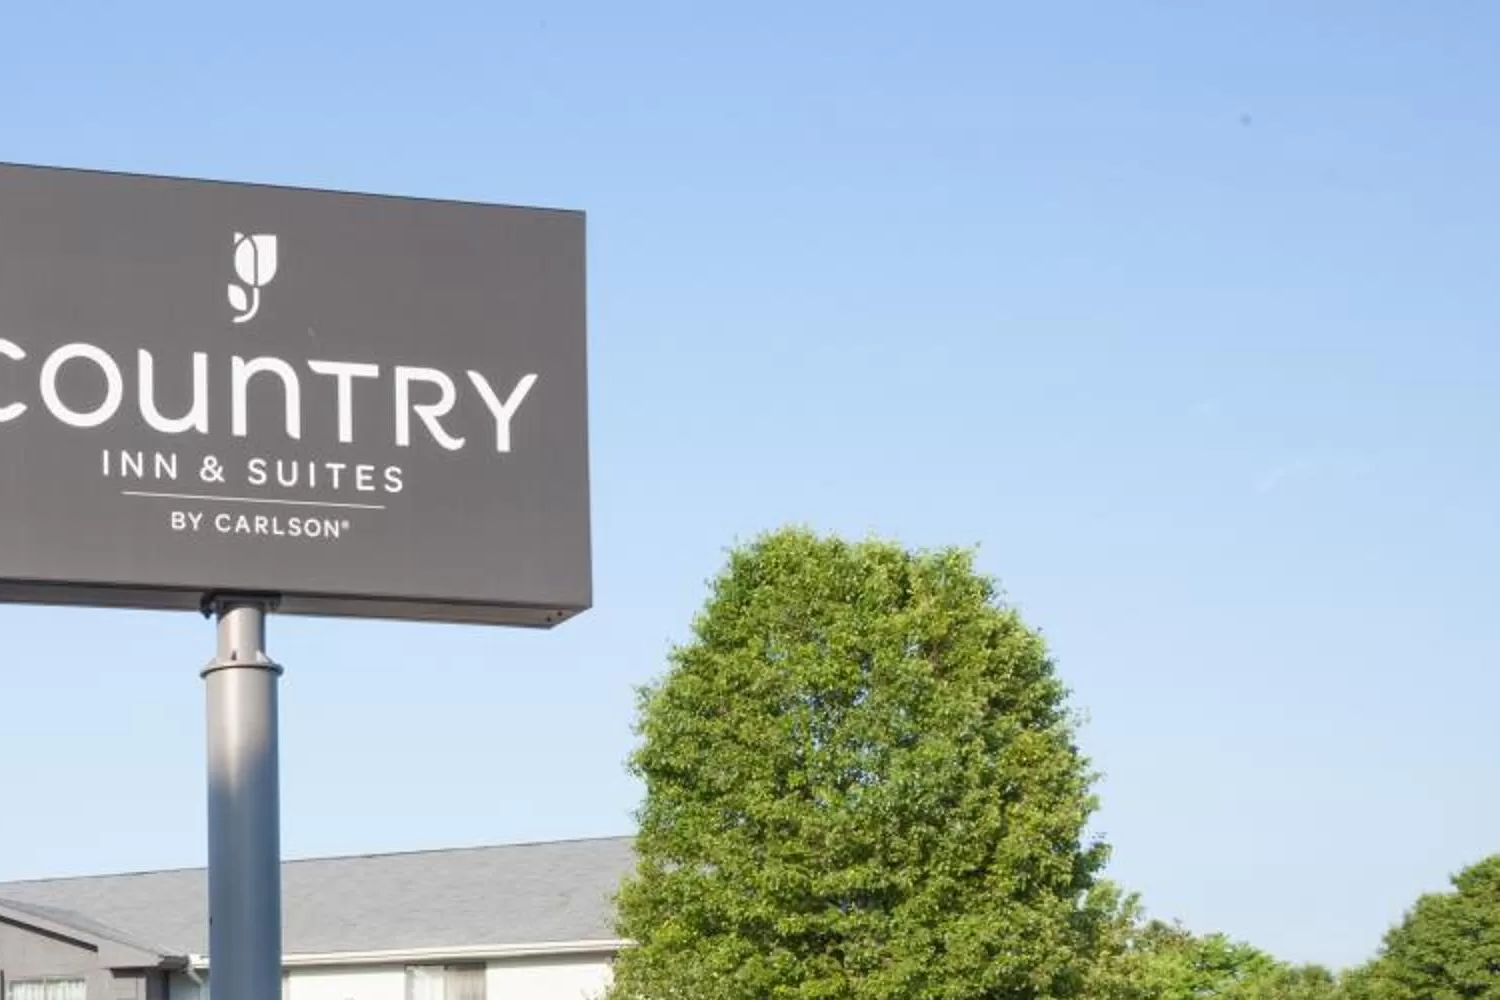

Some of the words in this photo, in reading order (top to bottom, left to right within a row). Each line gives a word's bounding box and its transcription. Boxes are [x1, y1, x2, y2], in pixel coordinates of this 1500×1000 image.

[102, 449, 178, 480] INN
[199, 455, 226, 483] &
[247, 457, 404, 493] SUITES
[171, 511, 203, 531] BY
